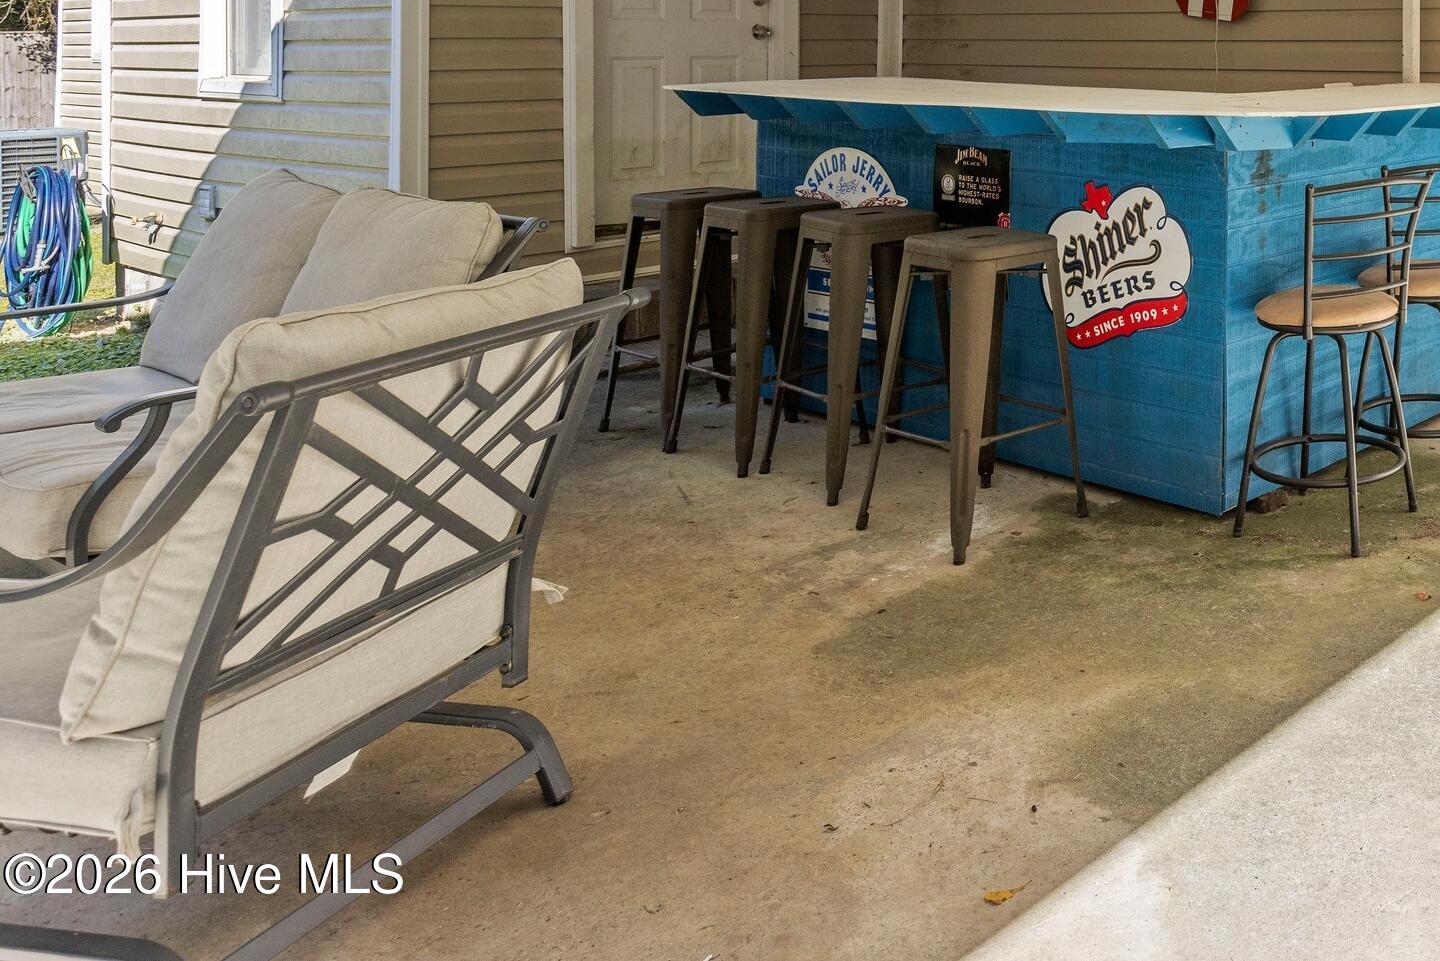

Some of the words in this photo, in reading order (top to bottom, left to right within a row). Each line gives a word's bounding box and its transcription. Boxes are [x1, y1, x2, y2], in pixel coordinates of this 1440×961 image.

[955, 148, 969, 164] JIM
[969, 147, 988, 167] BEAM
[808, 152, 847, 192] SAILOR
[852, 156, 891, 198] JERRY
[958, 174, 974, 182] RAISE
[981, 177, 999, 185] GLASS
[966, 182, 977, 190] THE
[979, 184, 1002, 193] WORLD'S
[1062, 196, 1153, 298] Shiner
[1081, 270, 1156, 308] BEERS
[1093, 315, 1126, 337] SINCE
[1129, 308, 1158, 324] 1909
